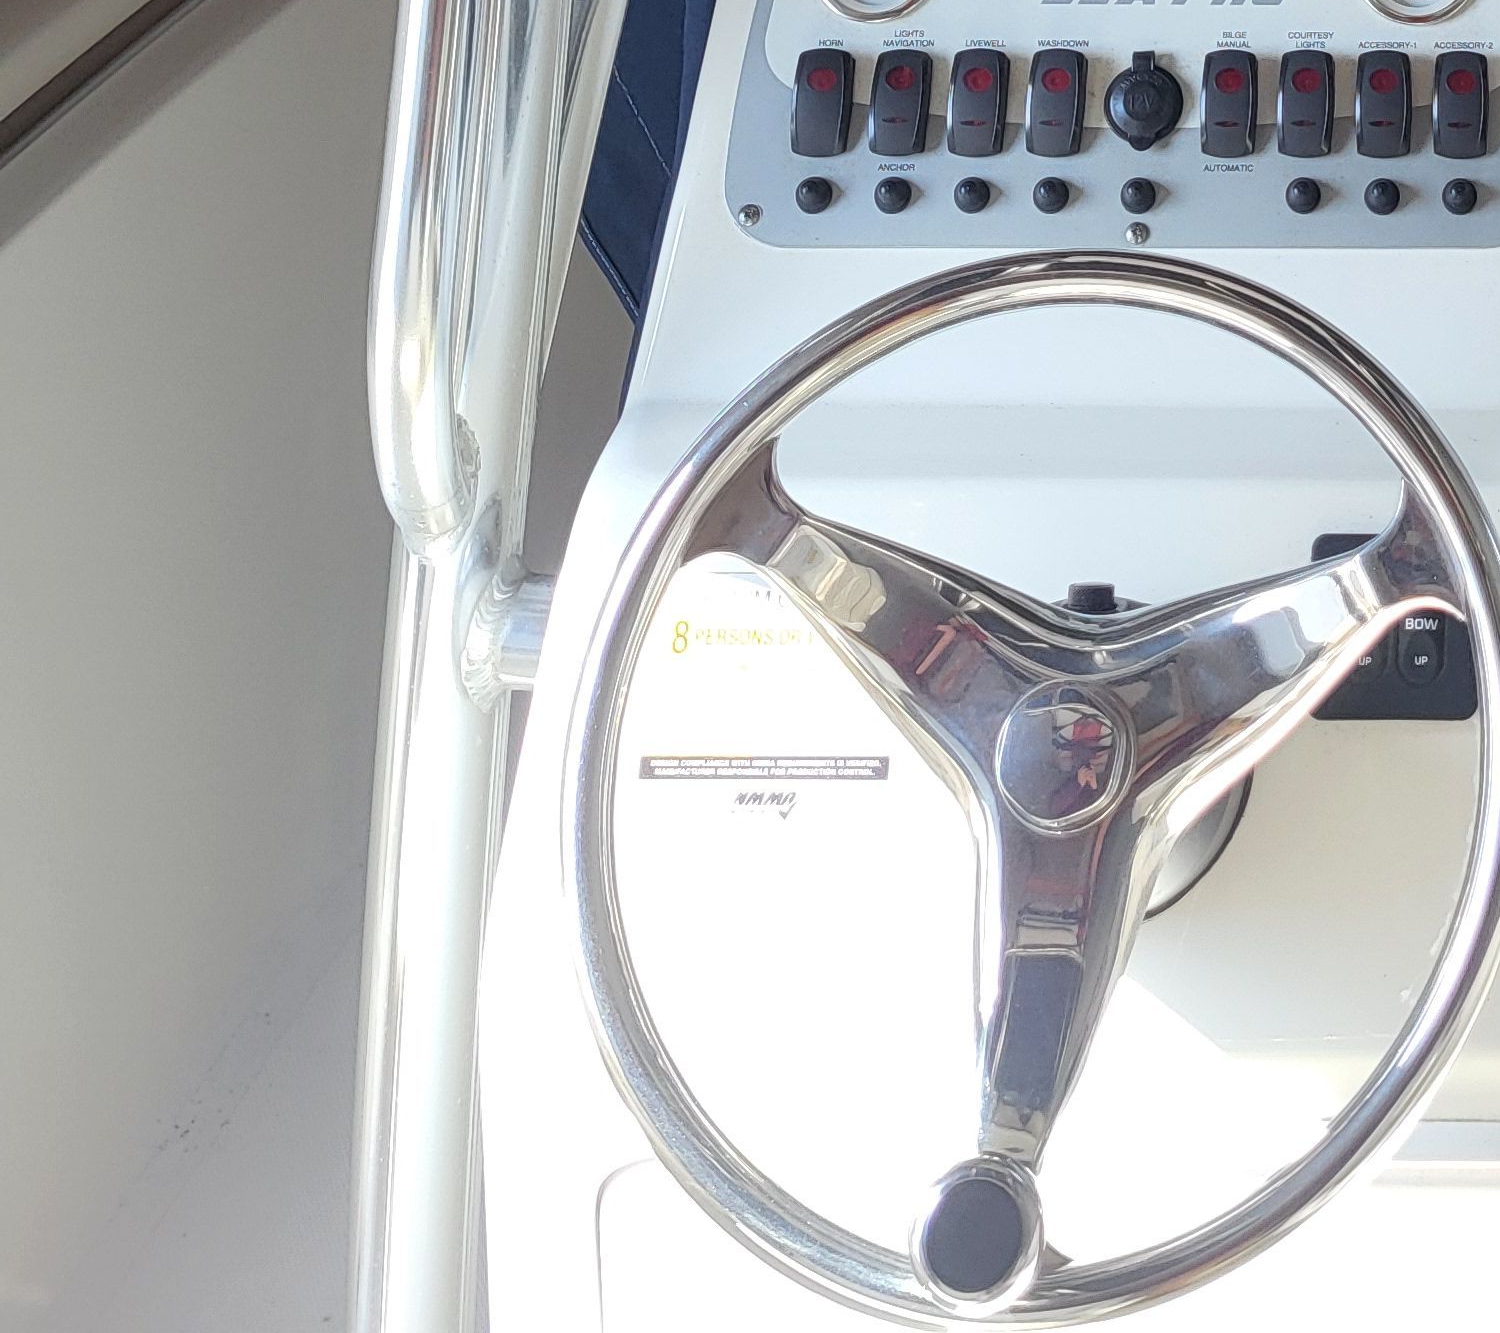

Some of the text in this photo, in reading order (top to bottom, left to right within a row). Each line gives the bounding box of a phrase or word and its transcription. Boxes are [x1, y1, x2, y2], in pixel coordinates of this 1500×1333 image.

[894, 30, 925, 38] LIGHTS
[1222, 31, 1248, 39] BILGE
[1288, 31, 1335, 40] COURTESY
[818, 39, 844, 47] HORN
[883, 39, 935, 47] NAVIGATION
[965, 39, 1007, 47] LIVEWELL
[1037, 39, 1089, 47] WASHDOWN
[1216, 41, 1252, 49] MANUAL
[1295, 41, 1326, 49] LIGHTS
[1358, 41, 1417, 50] ACCESSORY-1
[1434, 41, 1494, 50] ACCESSORY-2
[877, 163, 916, 172] ANCHOR
[1203, 164, 1255, 173] AUTOMATIC
[1405, 617, 1439, 631] BOW
[672, 620, 690, 654] 8
[1357, 655, 1429, 666] UP UP
